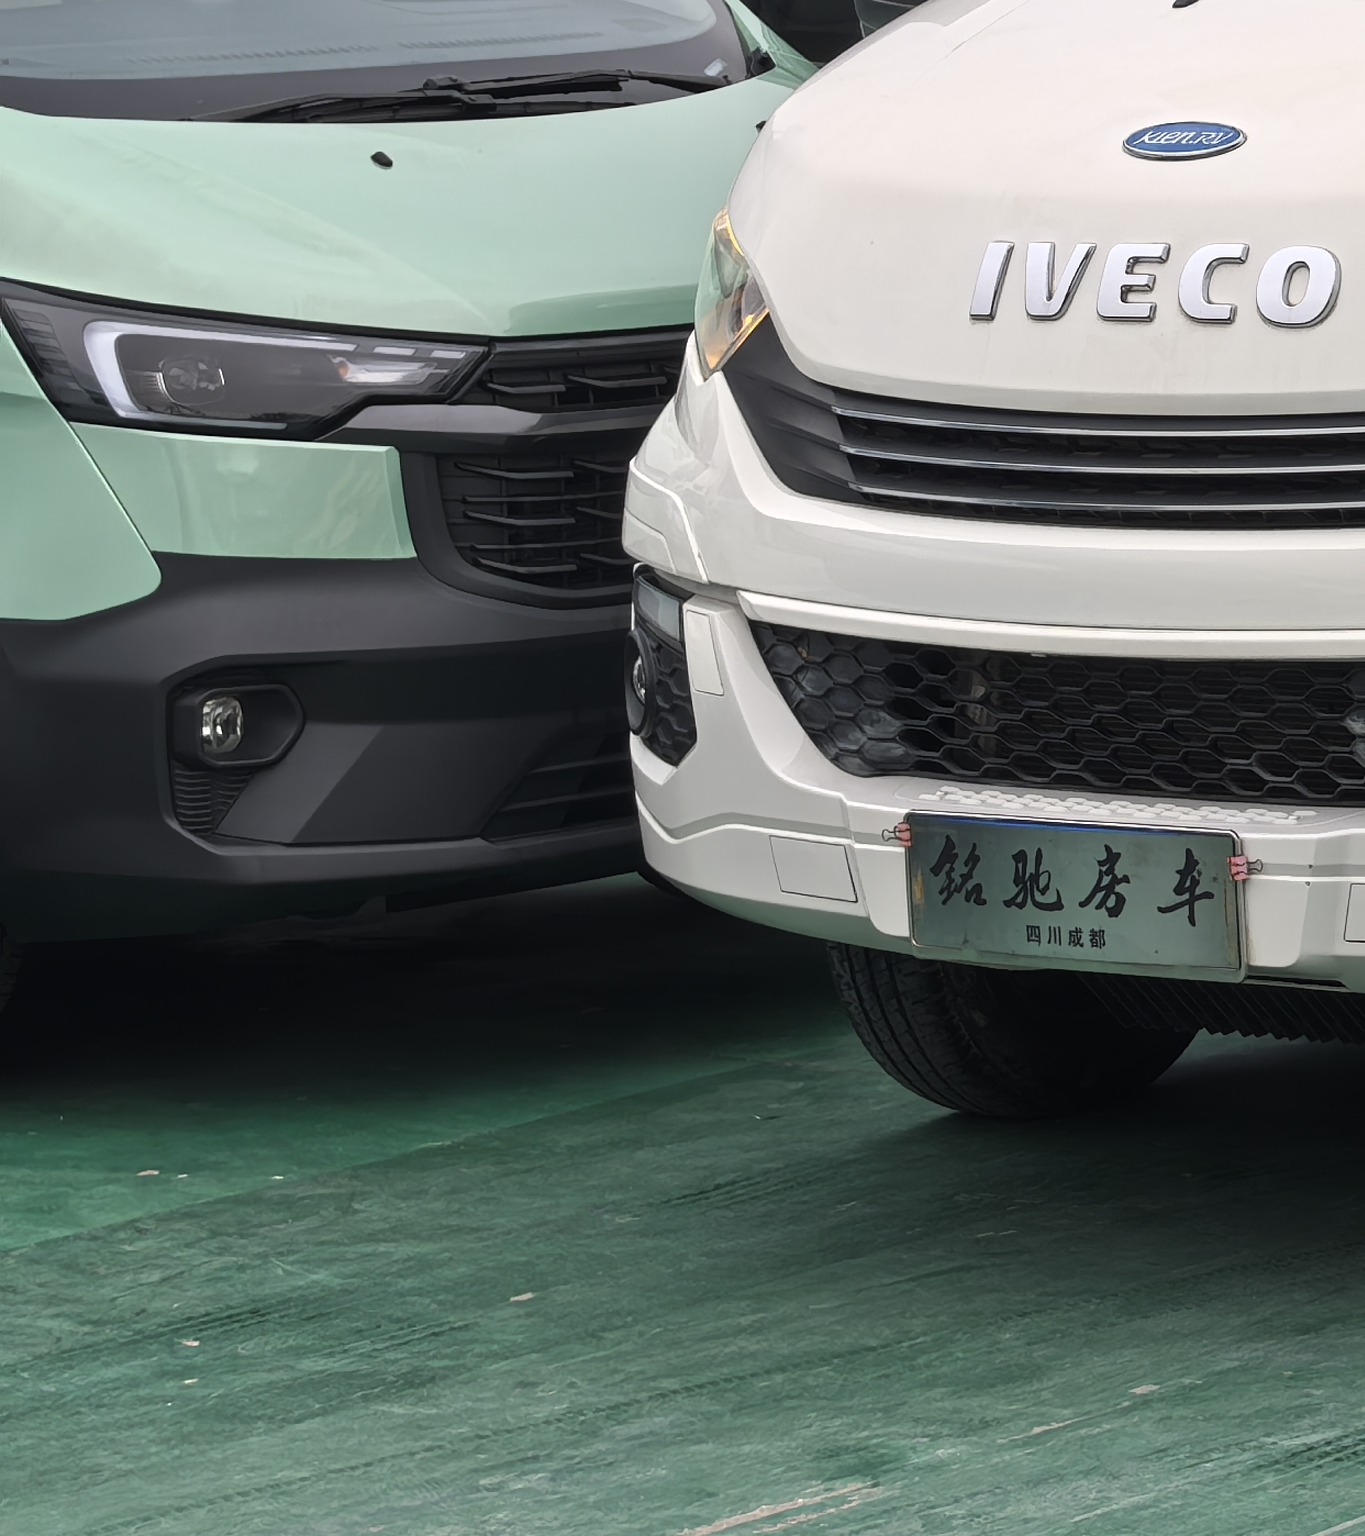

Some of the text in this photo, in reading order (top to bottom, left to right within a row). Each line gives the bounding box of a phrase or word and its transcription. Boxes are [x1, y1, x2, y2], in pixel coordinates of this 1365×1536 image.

[968, 240, 1343, 329] IVECO
[1025, 924, 1107, 949] 四川成都
